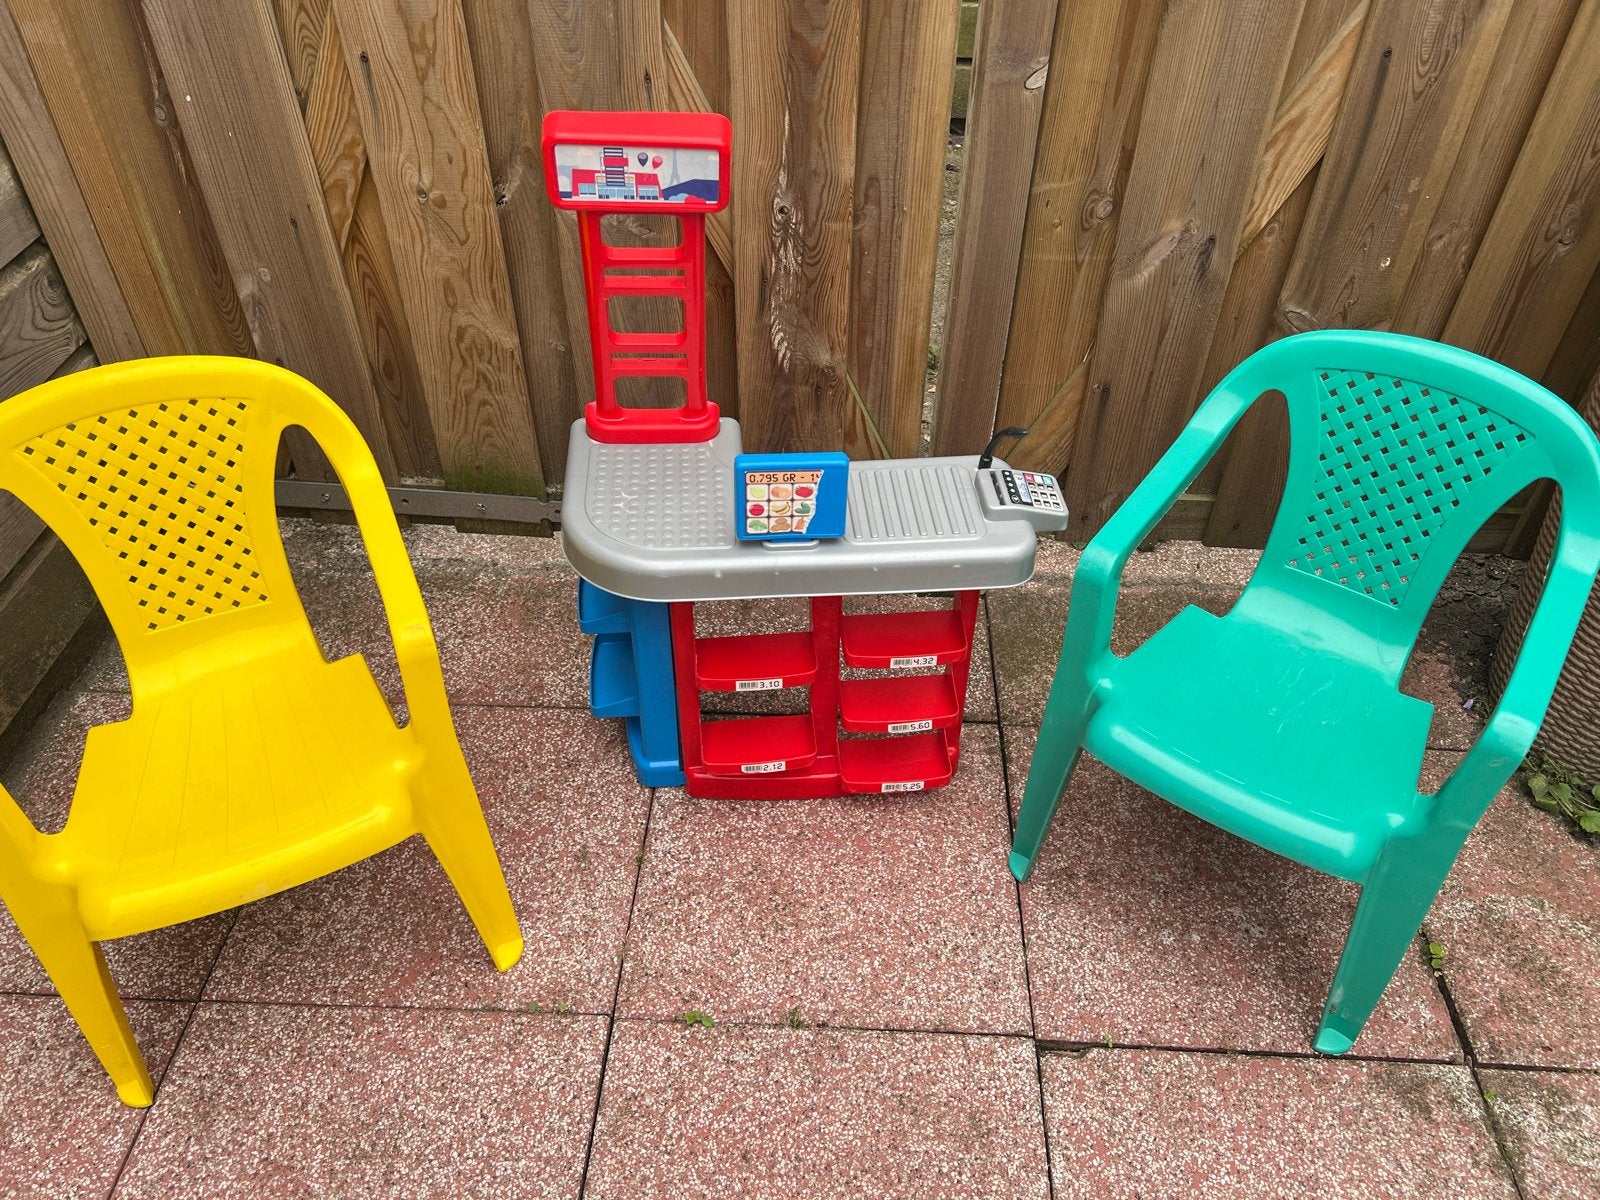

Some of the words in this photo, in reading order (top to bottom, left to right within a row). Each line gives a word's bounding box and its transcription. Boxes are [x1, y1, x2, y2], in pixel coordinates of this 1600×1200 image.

[749, 473, 779, 483] 0.795
[782, 473, 796, 482] GR
[913, 657, 934, 665] 4.32
[759, 680, 780, 689] 3.10
[910, 721, 930, 731] 5.60
[763, 762, 783, 772] 2.12
[902, 782, 921, 790] 5.25
